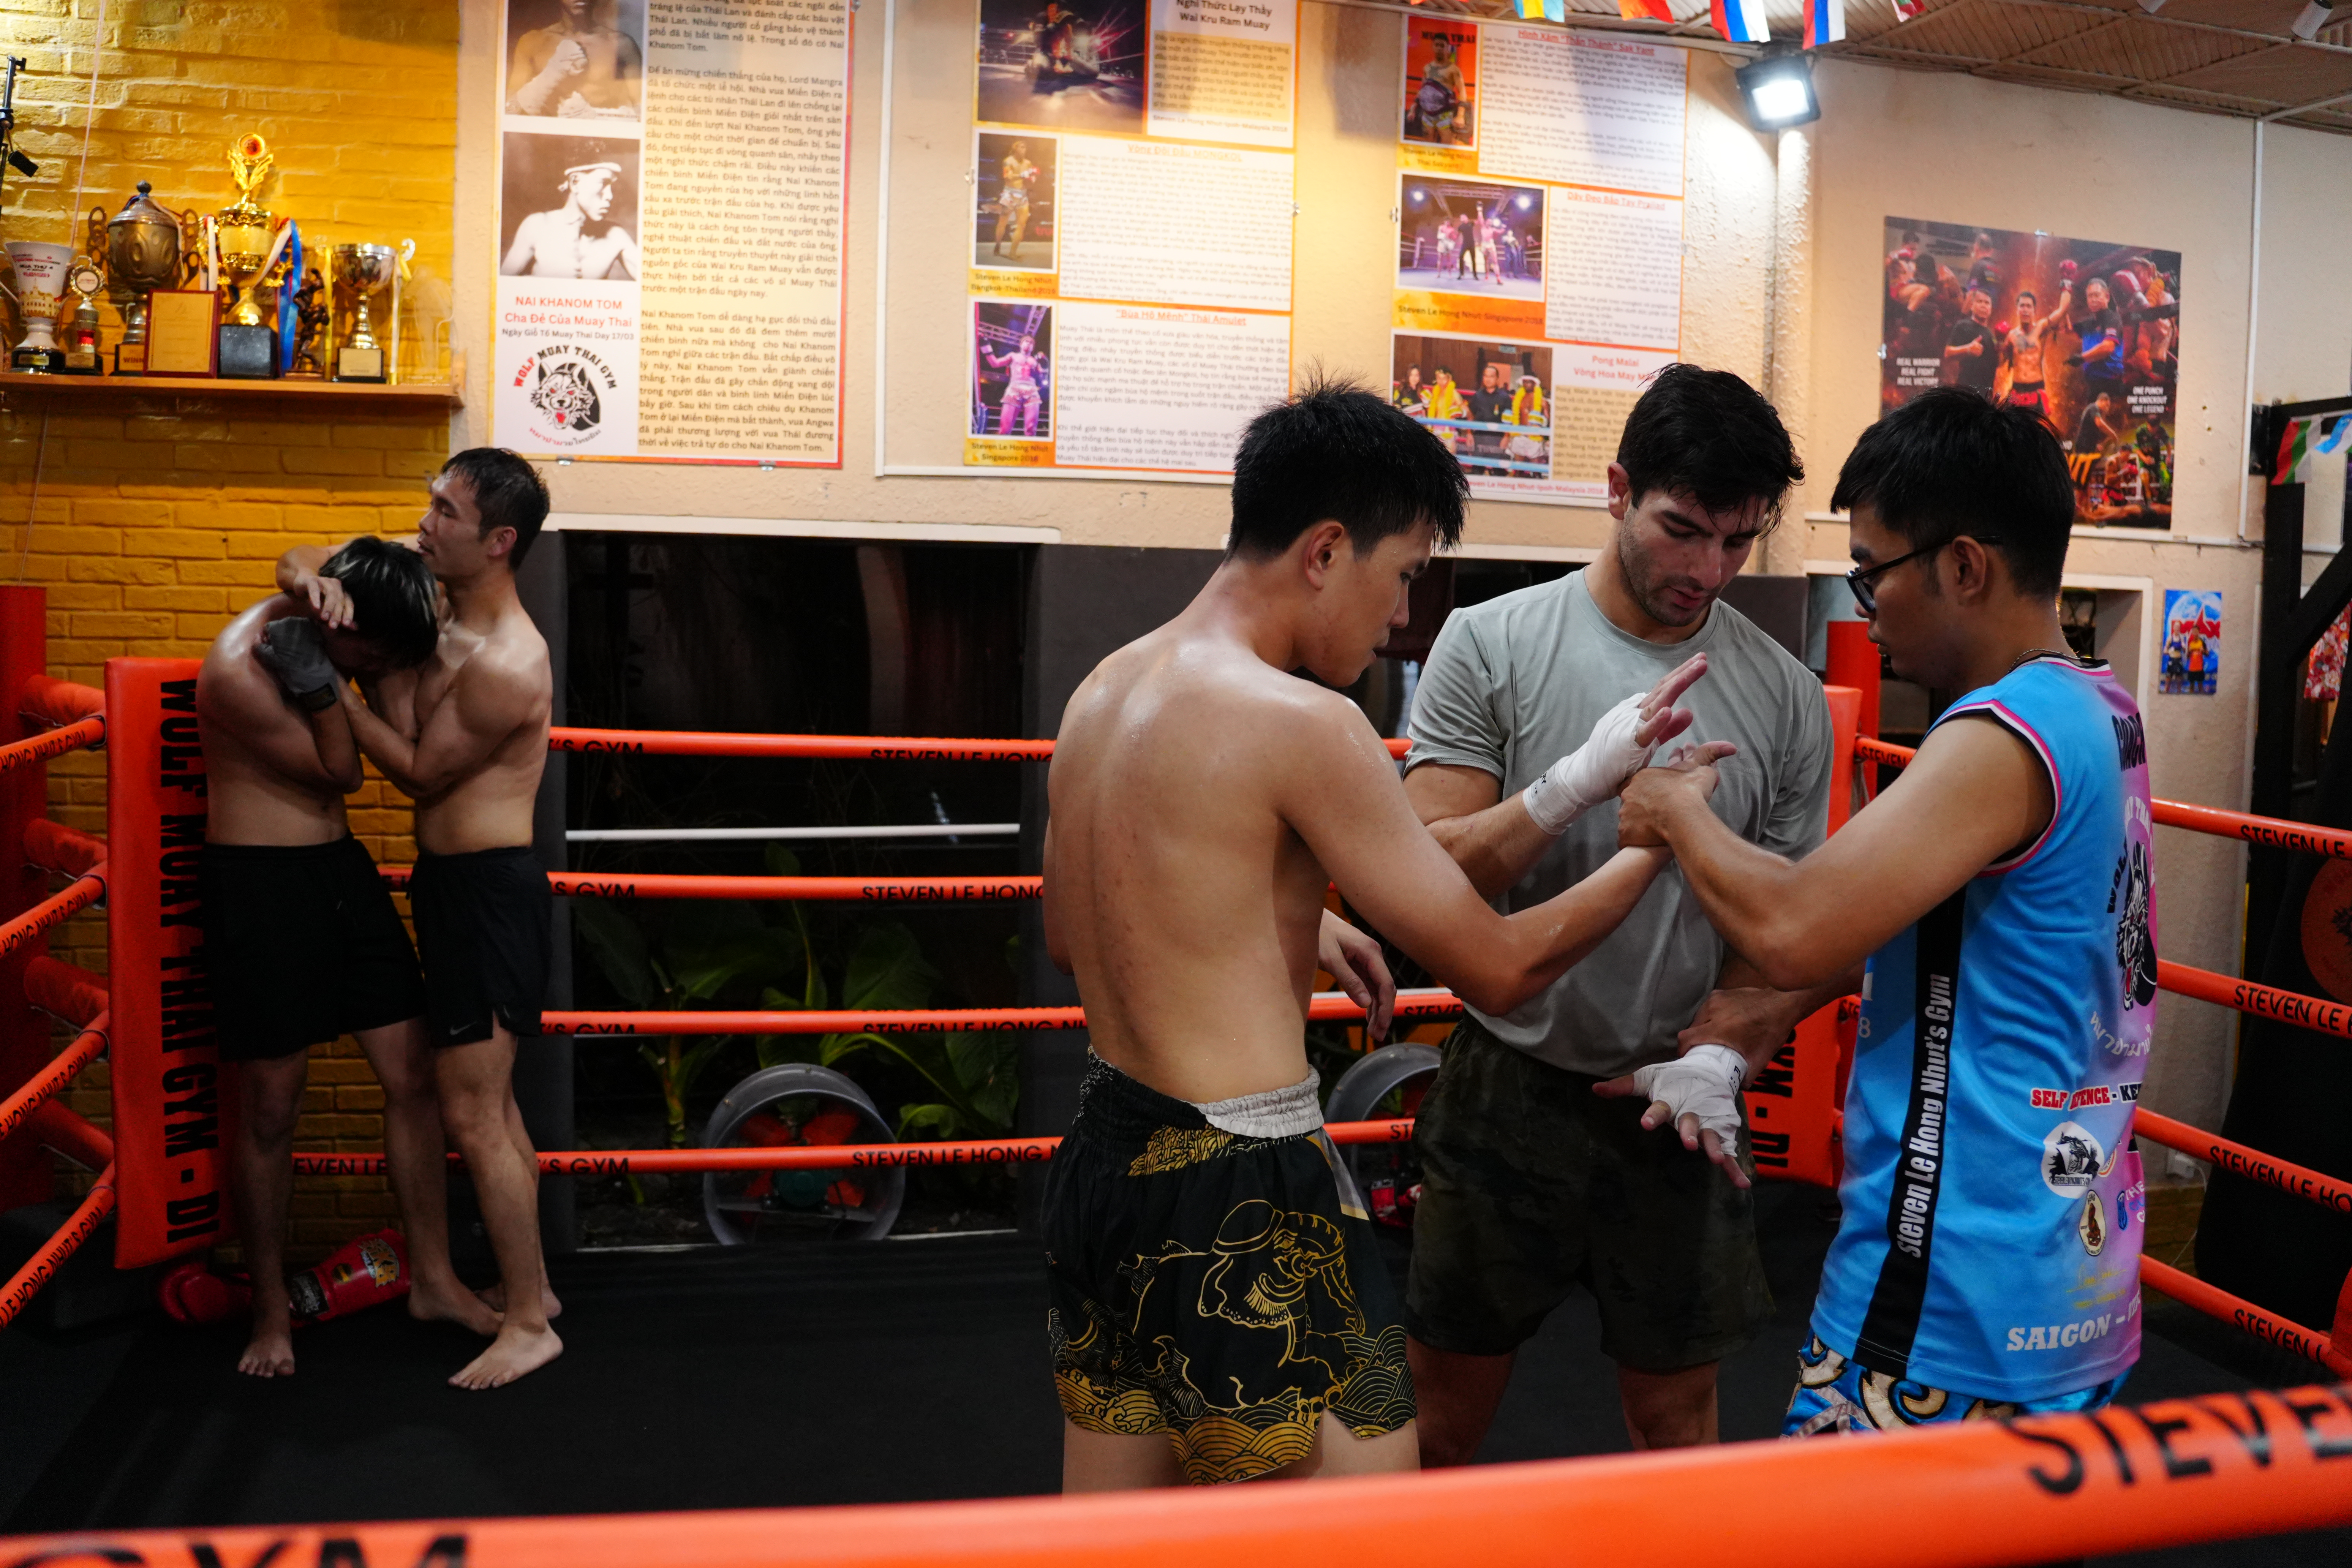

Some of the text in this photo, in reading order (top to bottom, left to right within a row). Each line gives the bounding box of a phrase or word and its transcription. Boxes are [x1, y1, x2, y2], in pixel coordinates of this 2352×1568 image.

[1179, 12, 1270, 31] Wai Kru Ram Muay
[516, 296, 622, 310] NAI KHANOM TOM
[1192, 314, 1211, 323] Thái
[1213, 316, 1247, 326] Amulet
[1398, 305, 1426, 314] Steven
[1439, 309, 1460, 319] Hong
[505, 313, 632, 329] Cha Đẻ Của Muay Thai
[502, 328, 522, 337] Ngày
[552, 330, 574, 340] Muay
[595, 332, 610, 341] Day
[514, 345, 617, 390] WOLF MUAY THAI GYM
[1592, 355, 1639, 367] Pong Malai
[1896, 357, 1912, 366] REAL
[1574, 367, 1596, 379] Vòng
[1598, 370, 1615, 379] Hoa
[1618, 371, 1635, 382] May
[1900, 367, 1916, 376] REAL
[1897, 376, 1912, 386] REAL
[2133, 386, 2164, 395] ONE PUNCH
[2127, 395, 2138, 404] ONE
[2131, 405, 2165, 414] ONE LEGEND
[805, 418, 834, 428] Angwa
[160, 678, 208, 798] WOLF
[989, 752, 1053, 761] HON
[1861, 746, 1907, 767] STEVEN
[2240, 824, 2346, 858] STEVEN LE
[576, 882, 635, 897] GYM
[862, 885, 944, 899] STEVEN
[2234, 985, 2343, 1031] STEVEN LE
[2031, 1088, 2069, 1110] SELF
[162, 1064, 219, 1158] GYM
[1896, 973, 1951, 1259] Steven Le Hong Nhut's Gym
[852, 1145, 1042, 1168] STEVEN LE HONG
[292, 1158, 356, 1175] EVEN
[569, 1158, 629, 1175] GYM
[2210, 1145, 2352, 1212] STEVEN LE HO
[79, 1206, 103, 1239] GYM
[167, 1190, 220, 1244] DI
[2006, 1313, 2112, 1351] SAIGON
[2234, 1308, 2310, 1359] STEVEN
[2000, 1392, 2352, 1496] STEVE
